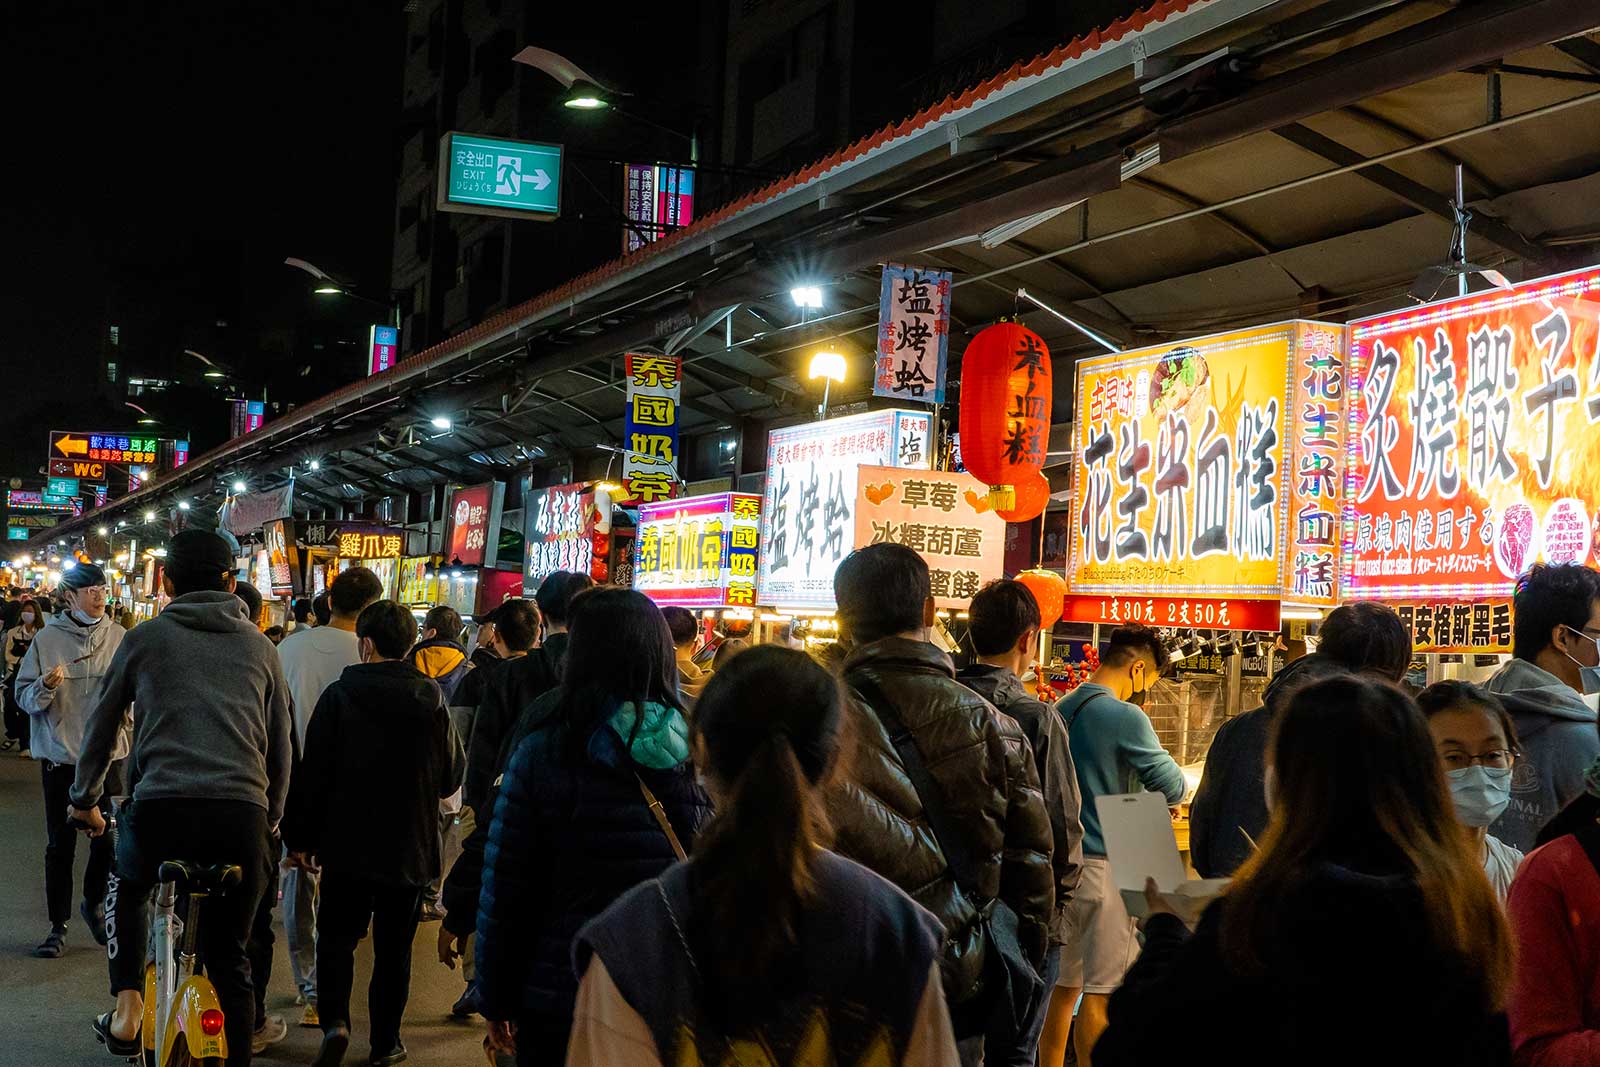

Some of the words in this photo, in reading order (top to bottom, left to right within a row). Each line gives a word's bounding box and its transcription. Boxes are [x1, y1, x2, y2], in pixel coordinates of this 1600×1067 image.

[456, 150, 494, 168] 安全出口
[463, 169, 486, 180] EXIT
[892, 271, 935, 397] 塩烤蛤
[1001, 334, 1048, 465] 米血糕
[1090, 375, 1133, 421] 古早味
[629, 356, 677, 502] 泰國奶茶
[898, 431, 922, 466] 塩
[73, 462, 103, 478] WC
[1082, 400, 1276, 562] 花生米血糕
[1294, 355, 1344, 598] 花生米血糕
[901, 479, 958, 513] 草莓
[306, 524, 340, 545] 懶人
[340, 533, 401, 558] 雞爪凍
[768, 459, 884, 579] 塩烤蛤
[870, 520, 983, 558] 冰糖葫蘆
[1357, 507, 1494, 552] 原塊肉使用する
[639, 516, 724, 584] 泰國奶茶
[727, 497, 760, 605] 泰國奶茶
[1101, 598, 1156, 623] 1支30元
[1168, 601, 1231, 626] 2支50元
[1388, 603, 1511, 647] 用安格斯黑毛
